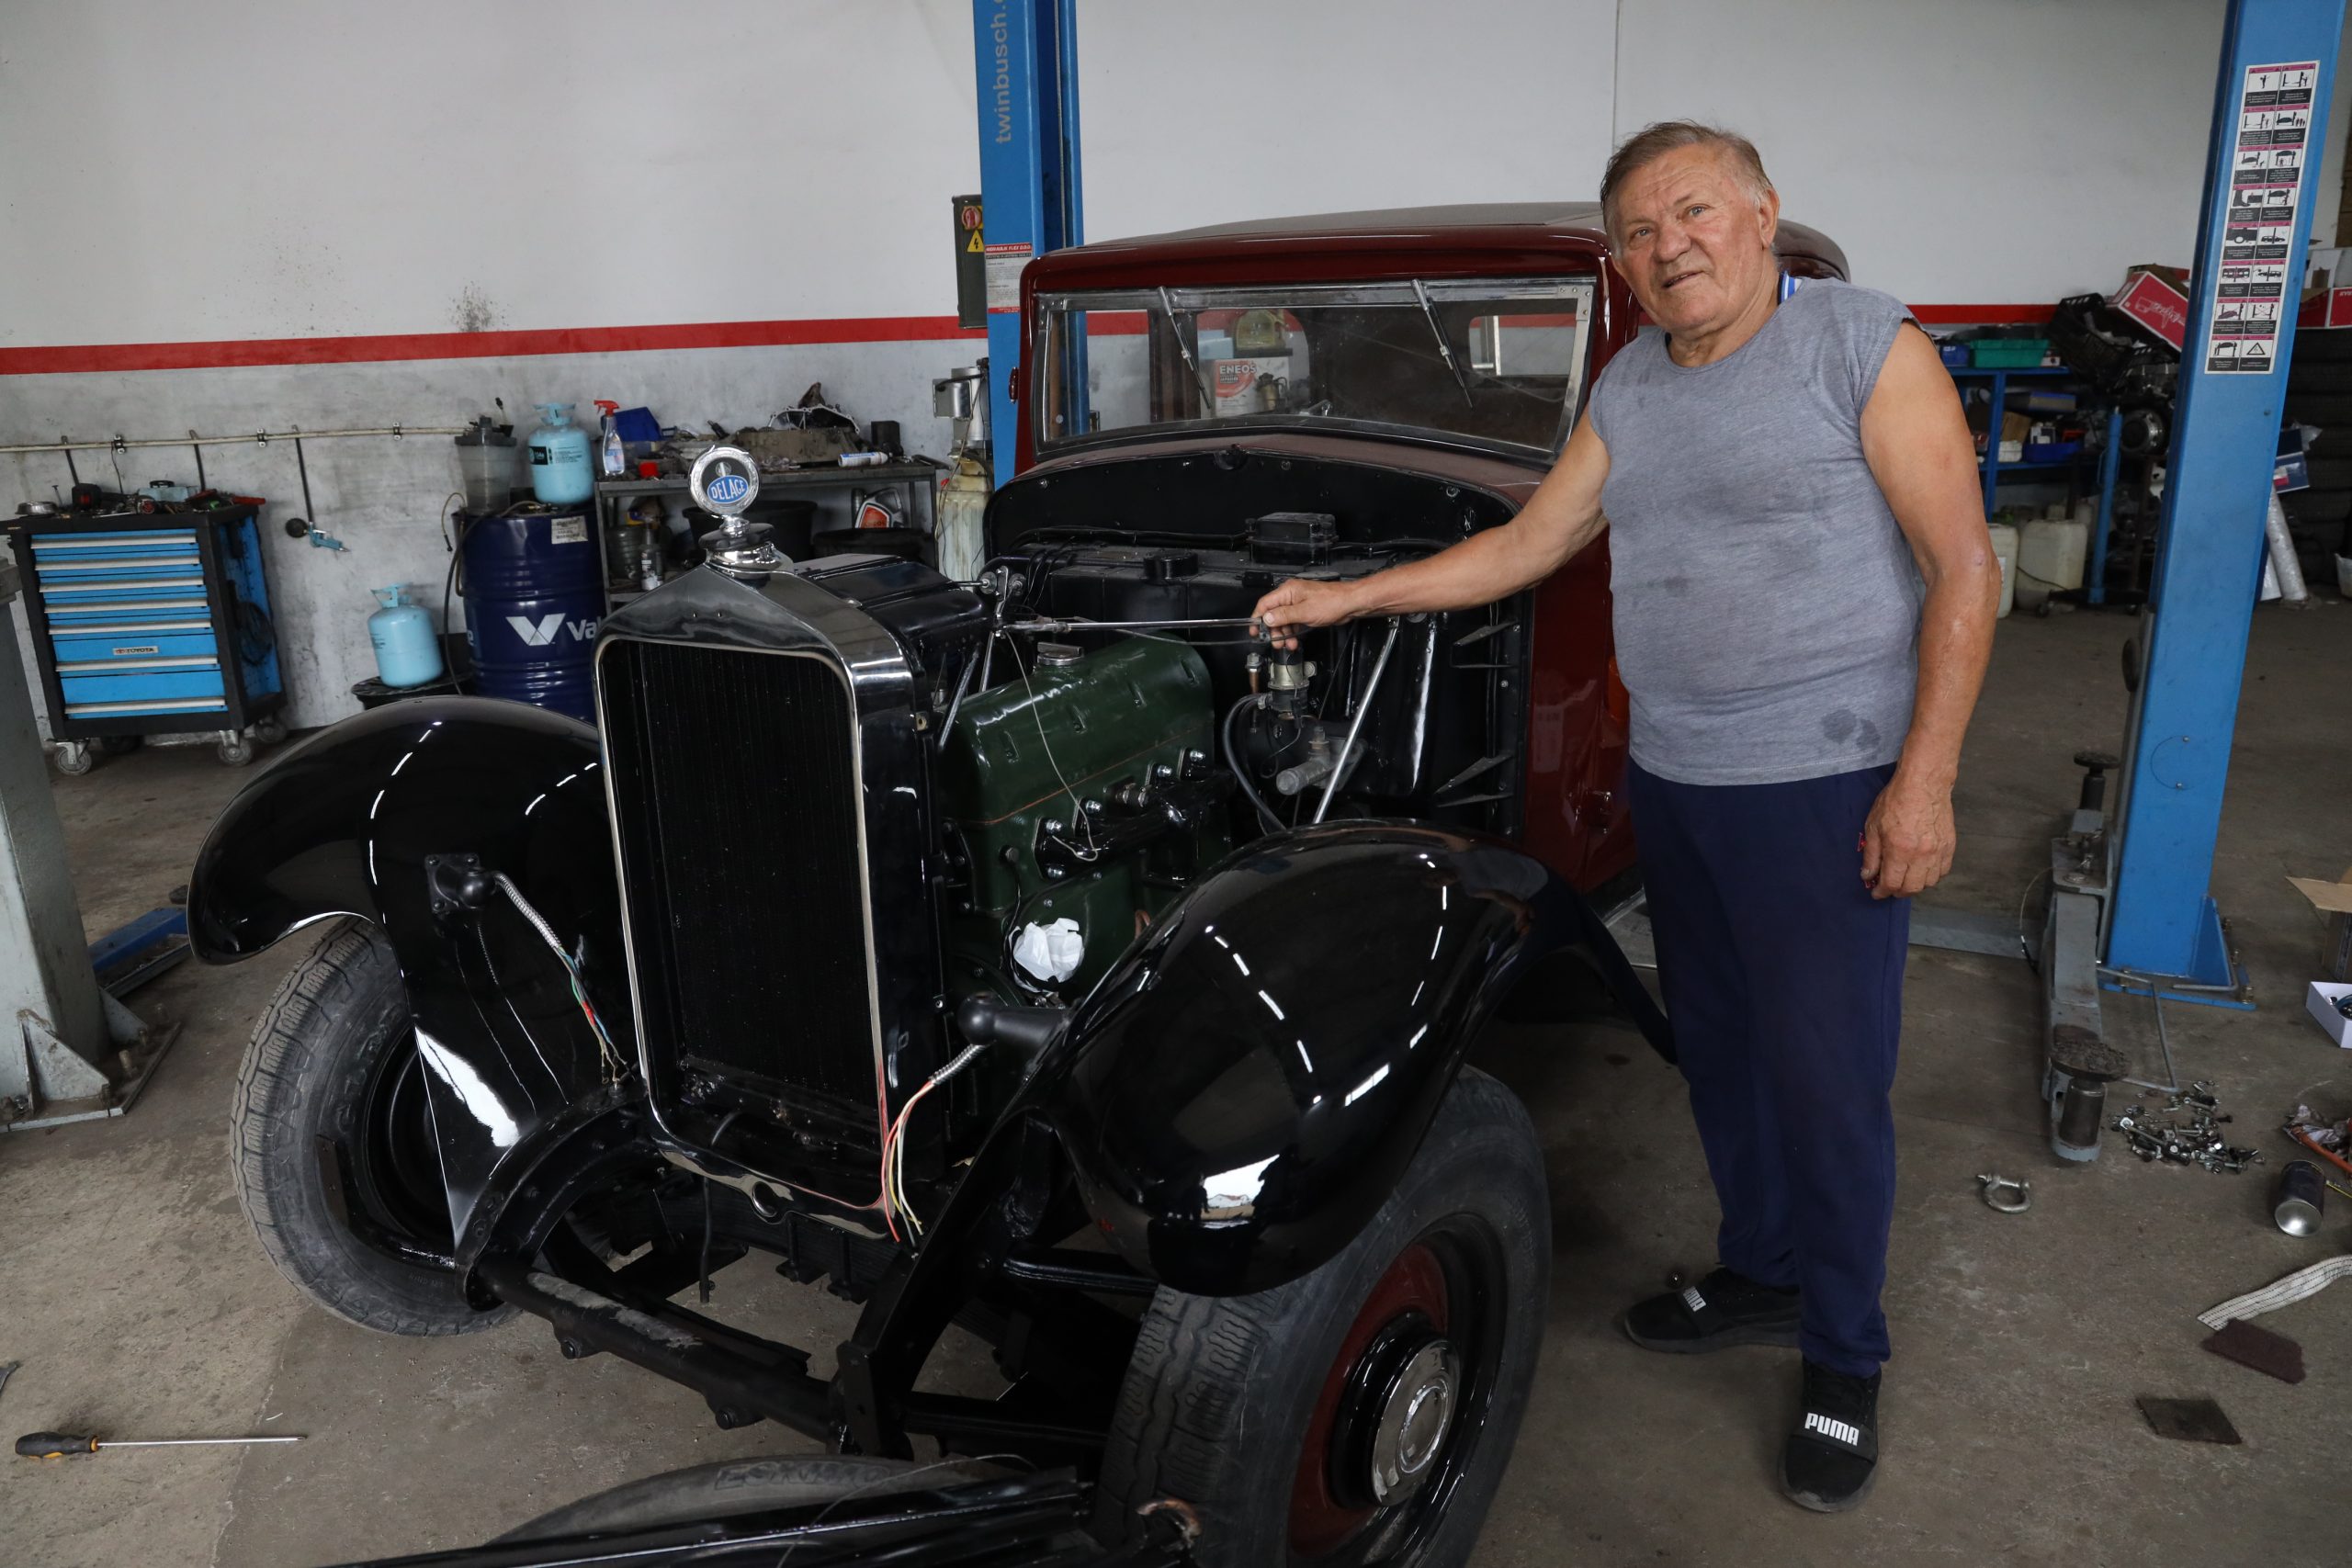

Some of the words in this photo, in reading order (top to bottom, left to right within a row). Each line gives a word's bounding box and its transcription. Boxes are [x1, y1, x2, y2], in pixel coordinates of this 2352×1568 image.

[1219, 364, 1258, 375] ENEOS
[710, 479, 746, 500] DELAGE
[1804, 1412, 1860, 1447] PUMA
